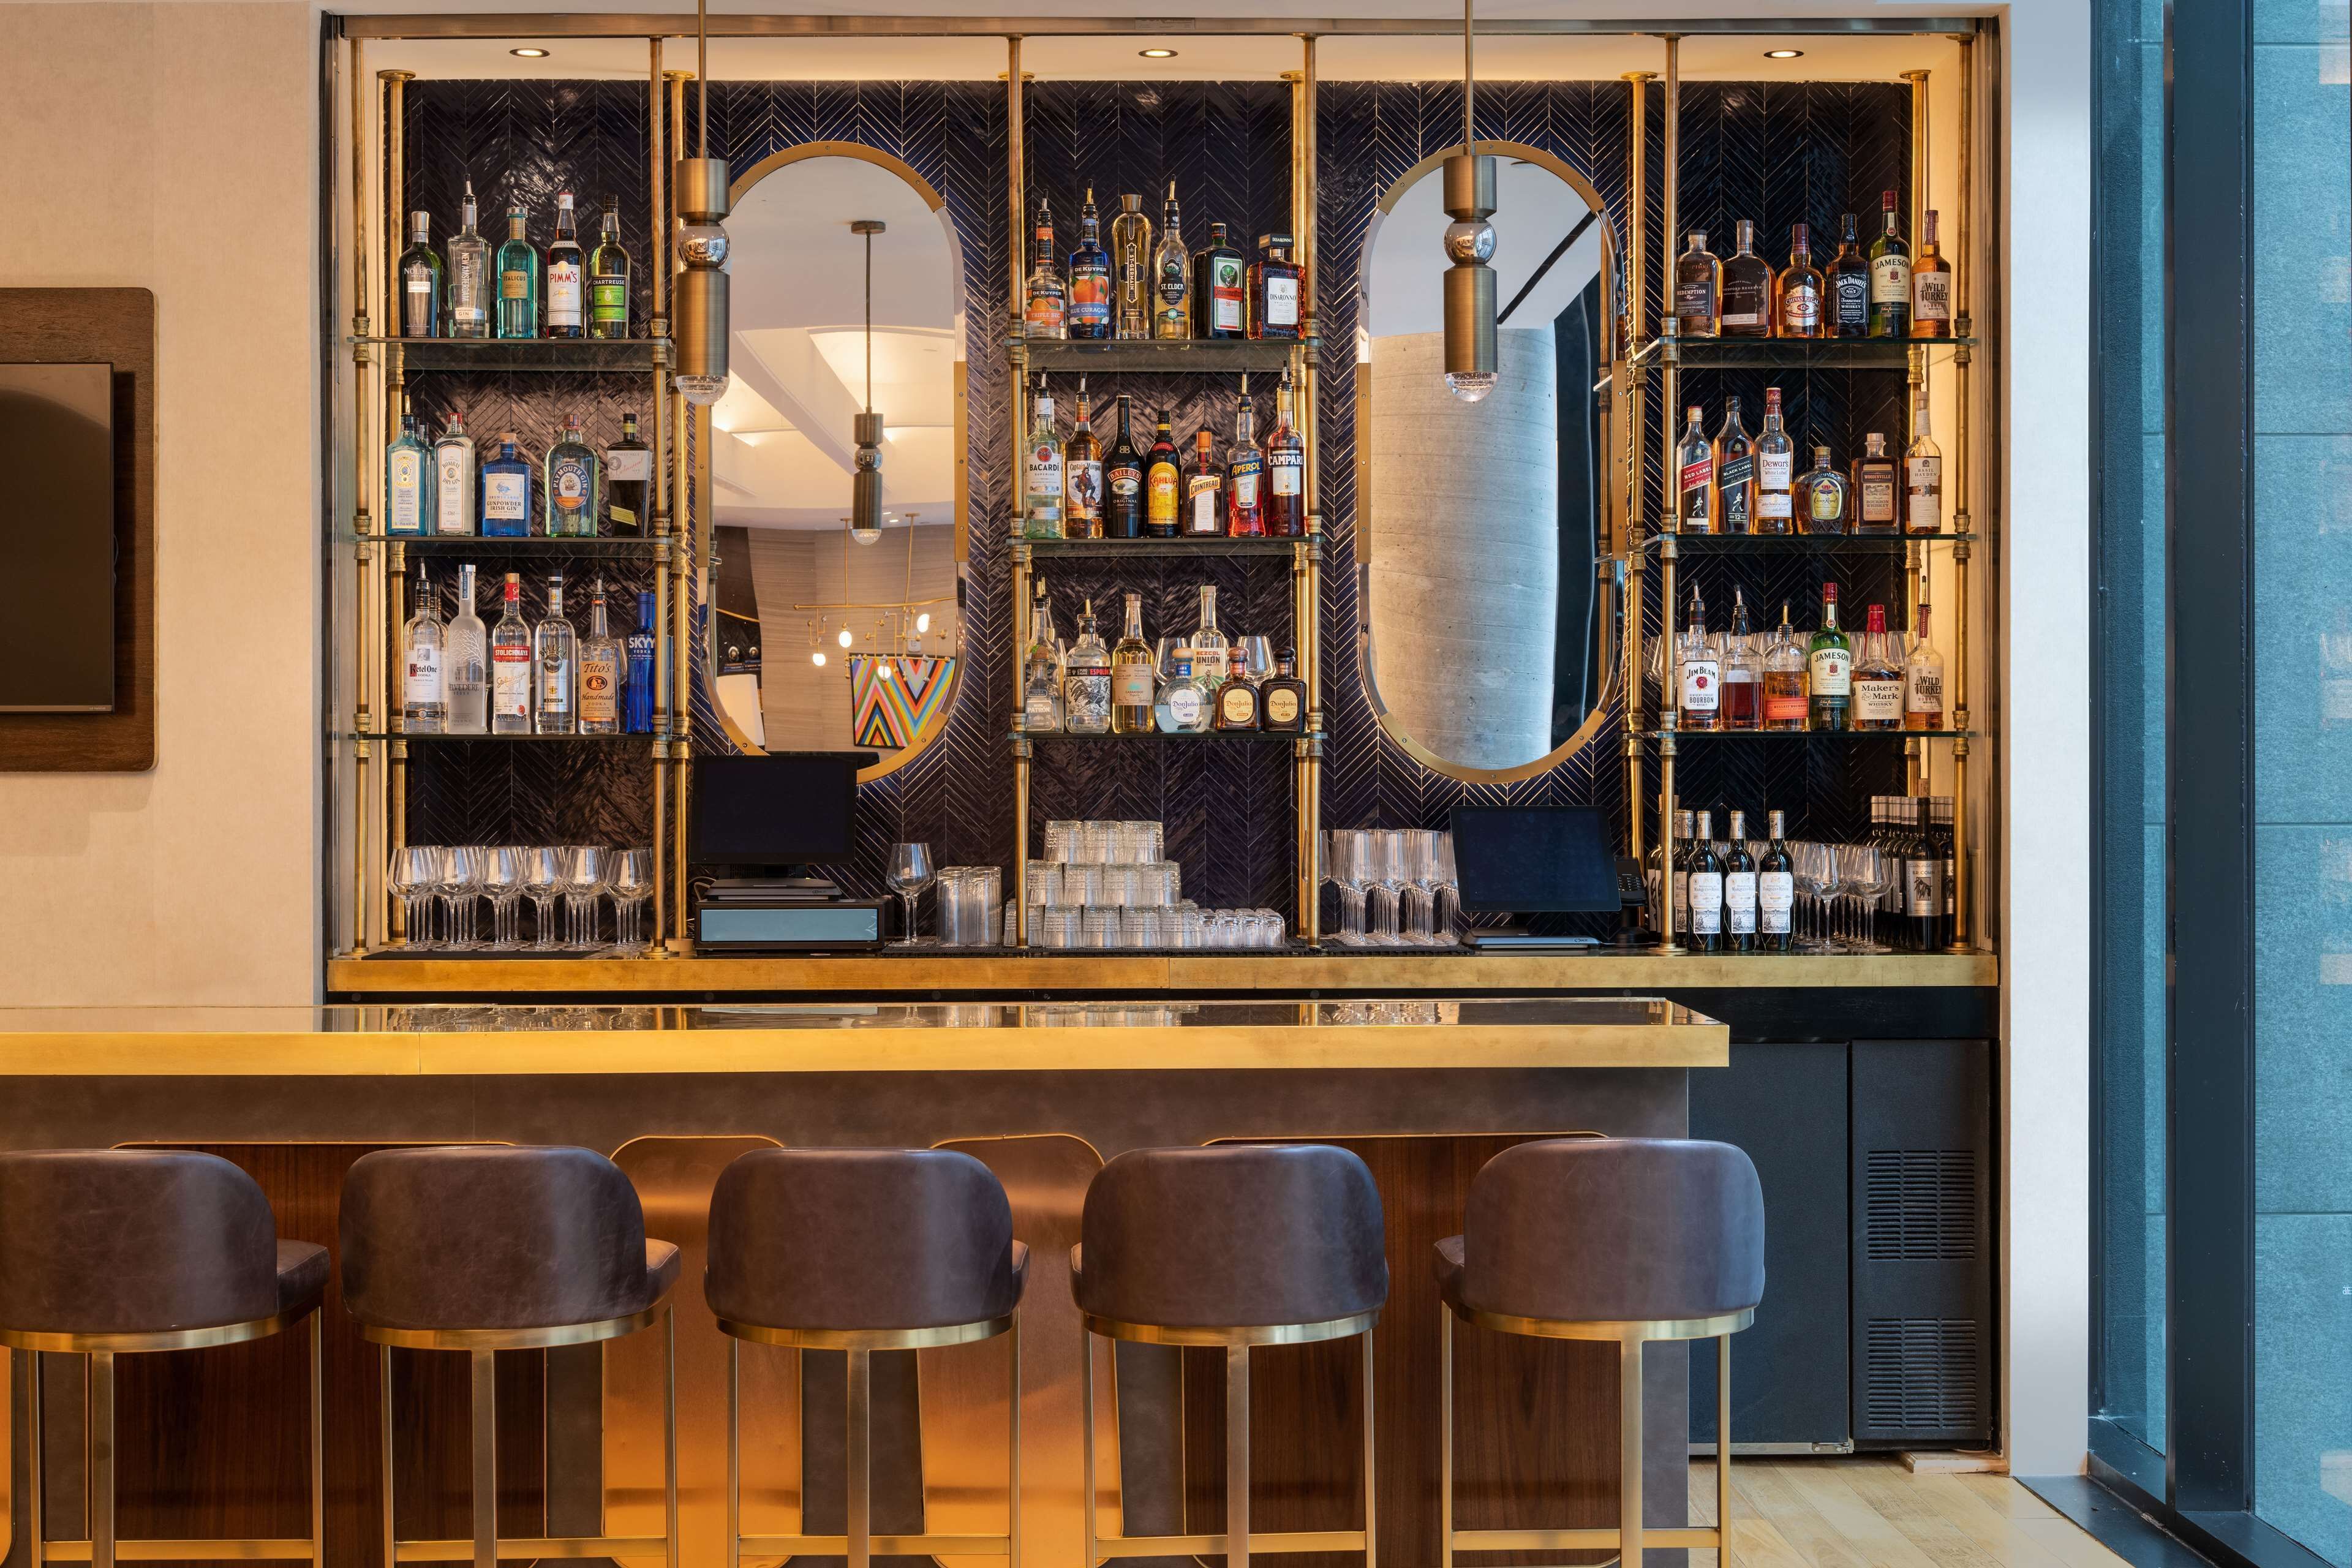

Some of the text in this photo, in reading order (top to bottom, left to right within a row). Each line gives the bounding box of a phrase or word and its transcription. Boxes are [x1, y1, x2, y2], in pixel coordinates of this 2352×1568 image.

[461, 252, 470, 265] NEW
[1875, 258, 1909, 270] JAMESON
[549, 271, 578, 284] PIMM'S
[1836, 276, 1868, 288] JACK DANIEL'S
[461, 266, 470, 301] AMSTERDAM
[1925, 282, 1945, 292] WILD
[1785, 296, 1819, 305] CHIVAS REGAL
[1920, 290, 1948, 301] TURKEY
[1268, 455, 1303, 466] CAMPARI
[1029, 462, 1059, 472] BACARDÍ
[1232, 462, 1261, 477] APEROL
[1696, 466, 1711, 475] LABEL
[553, 466, 589, 488] PLYMOUTH GIN
[1110, 469, 1140, 479] BAILEYS
[1149, 474, 1178, 488] KAHLÚA
[1191, 479, 1218, 495] COINTREAU
[628, 637, 655, 649] SKYY
[1815, 652, 1849, 662] JAMESON
[410, 665, 426, 674] Ketel
[583, 663, 611, 673] Tito's
[1686, 666, 1716, 679] JIM BEAM
[1920, 676, 1940, 686] WILD
[1915, 683, 1942, 695] TURKEY
[582, 692, 614, 701] Handmade
